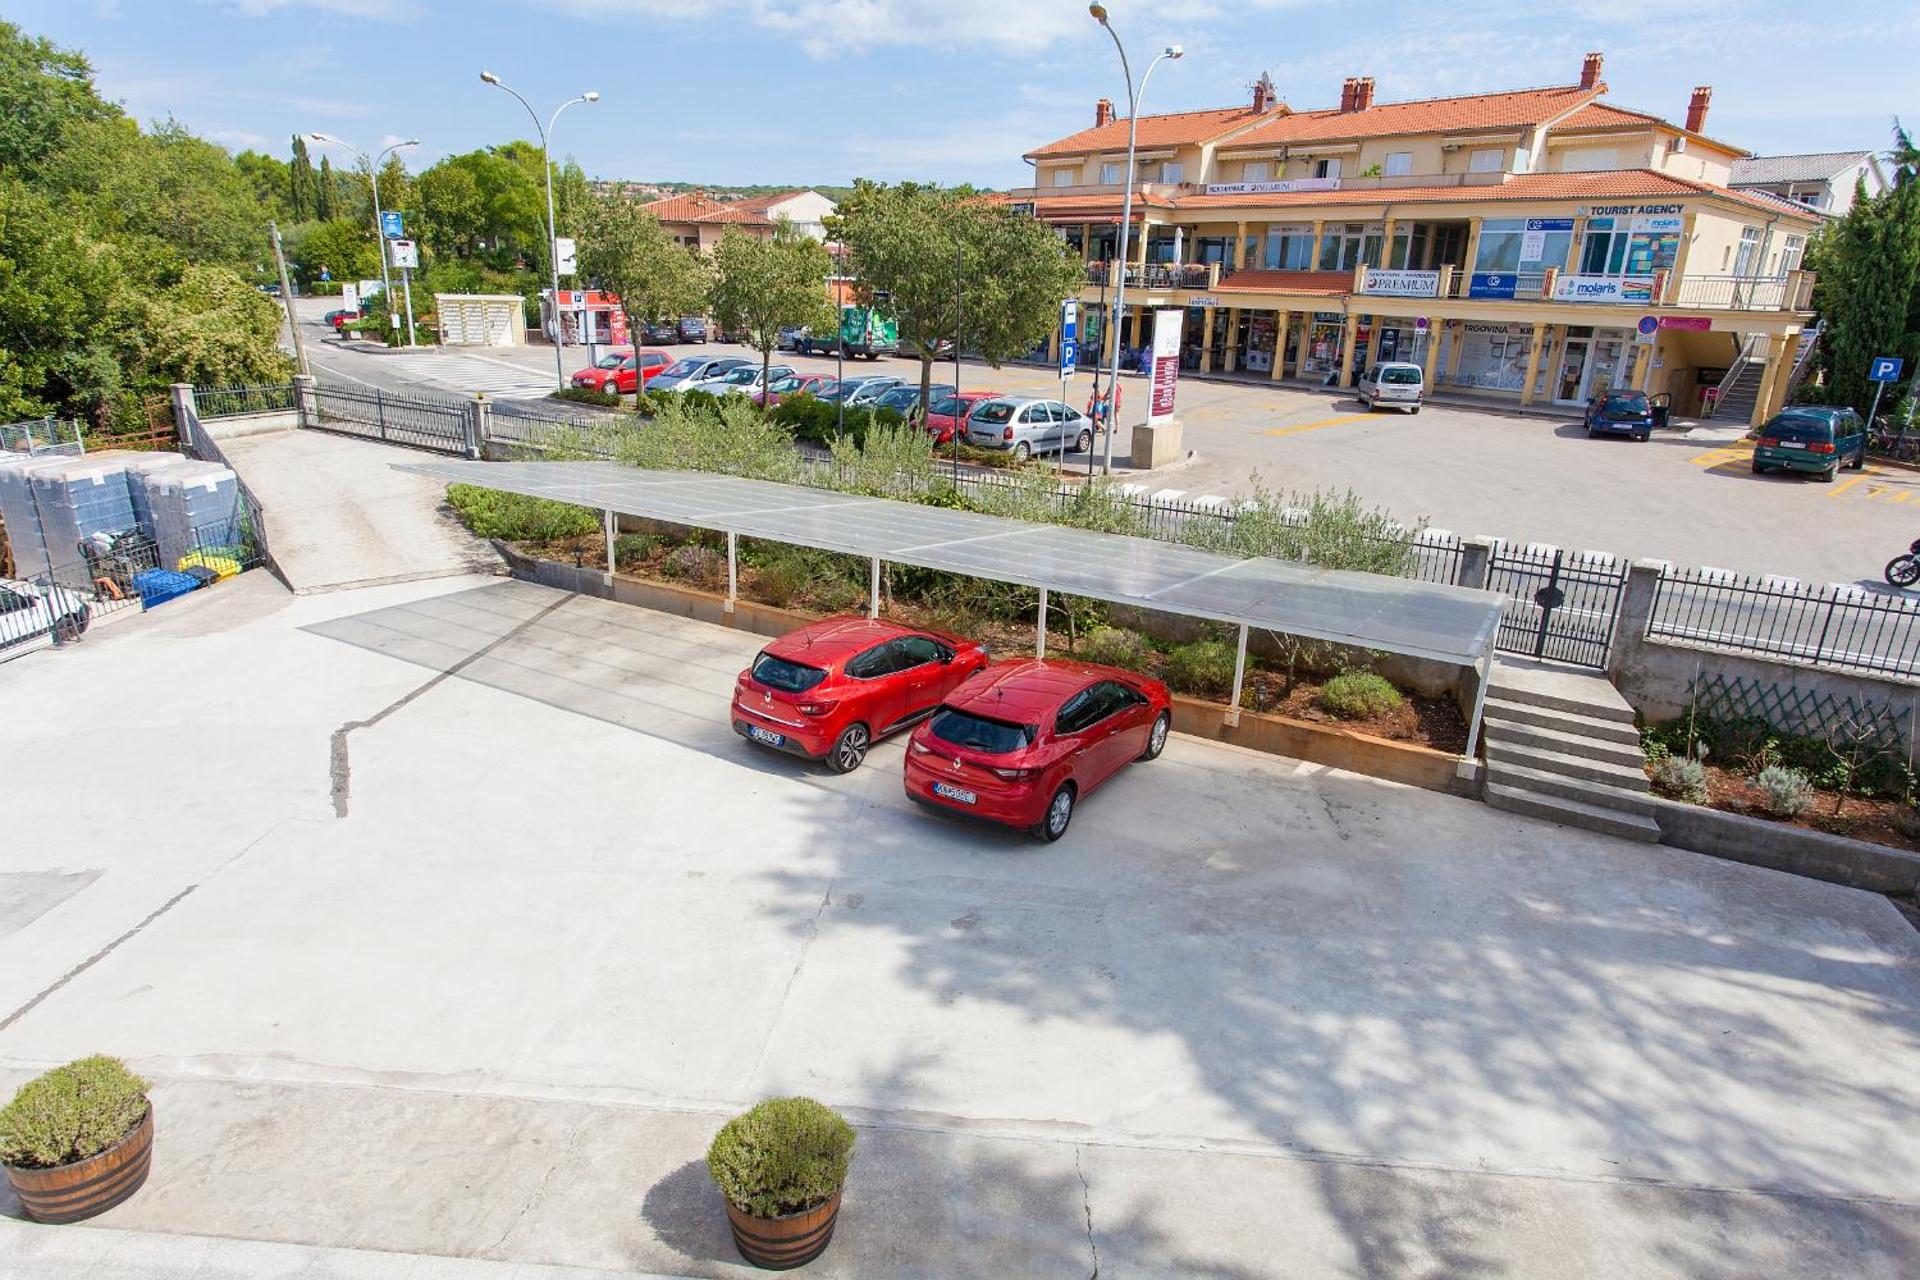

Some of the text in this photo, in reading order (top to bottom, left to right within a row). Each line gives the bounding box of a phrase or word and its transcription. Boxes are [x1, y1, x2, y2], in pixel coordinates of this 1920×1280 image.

[1591, 204, 1684, 216] TOURIST AGENCY
[1377, 278, 1435, 291] PREMIUM
[1576, 281, 1616, 294] molaris
[1464, 324, 1509, 334] TRGOVINA
[1065, 346, 1073, 364] P
[1877, 361, 1894, 377] P
